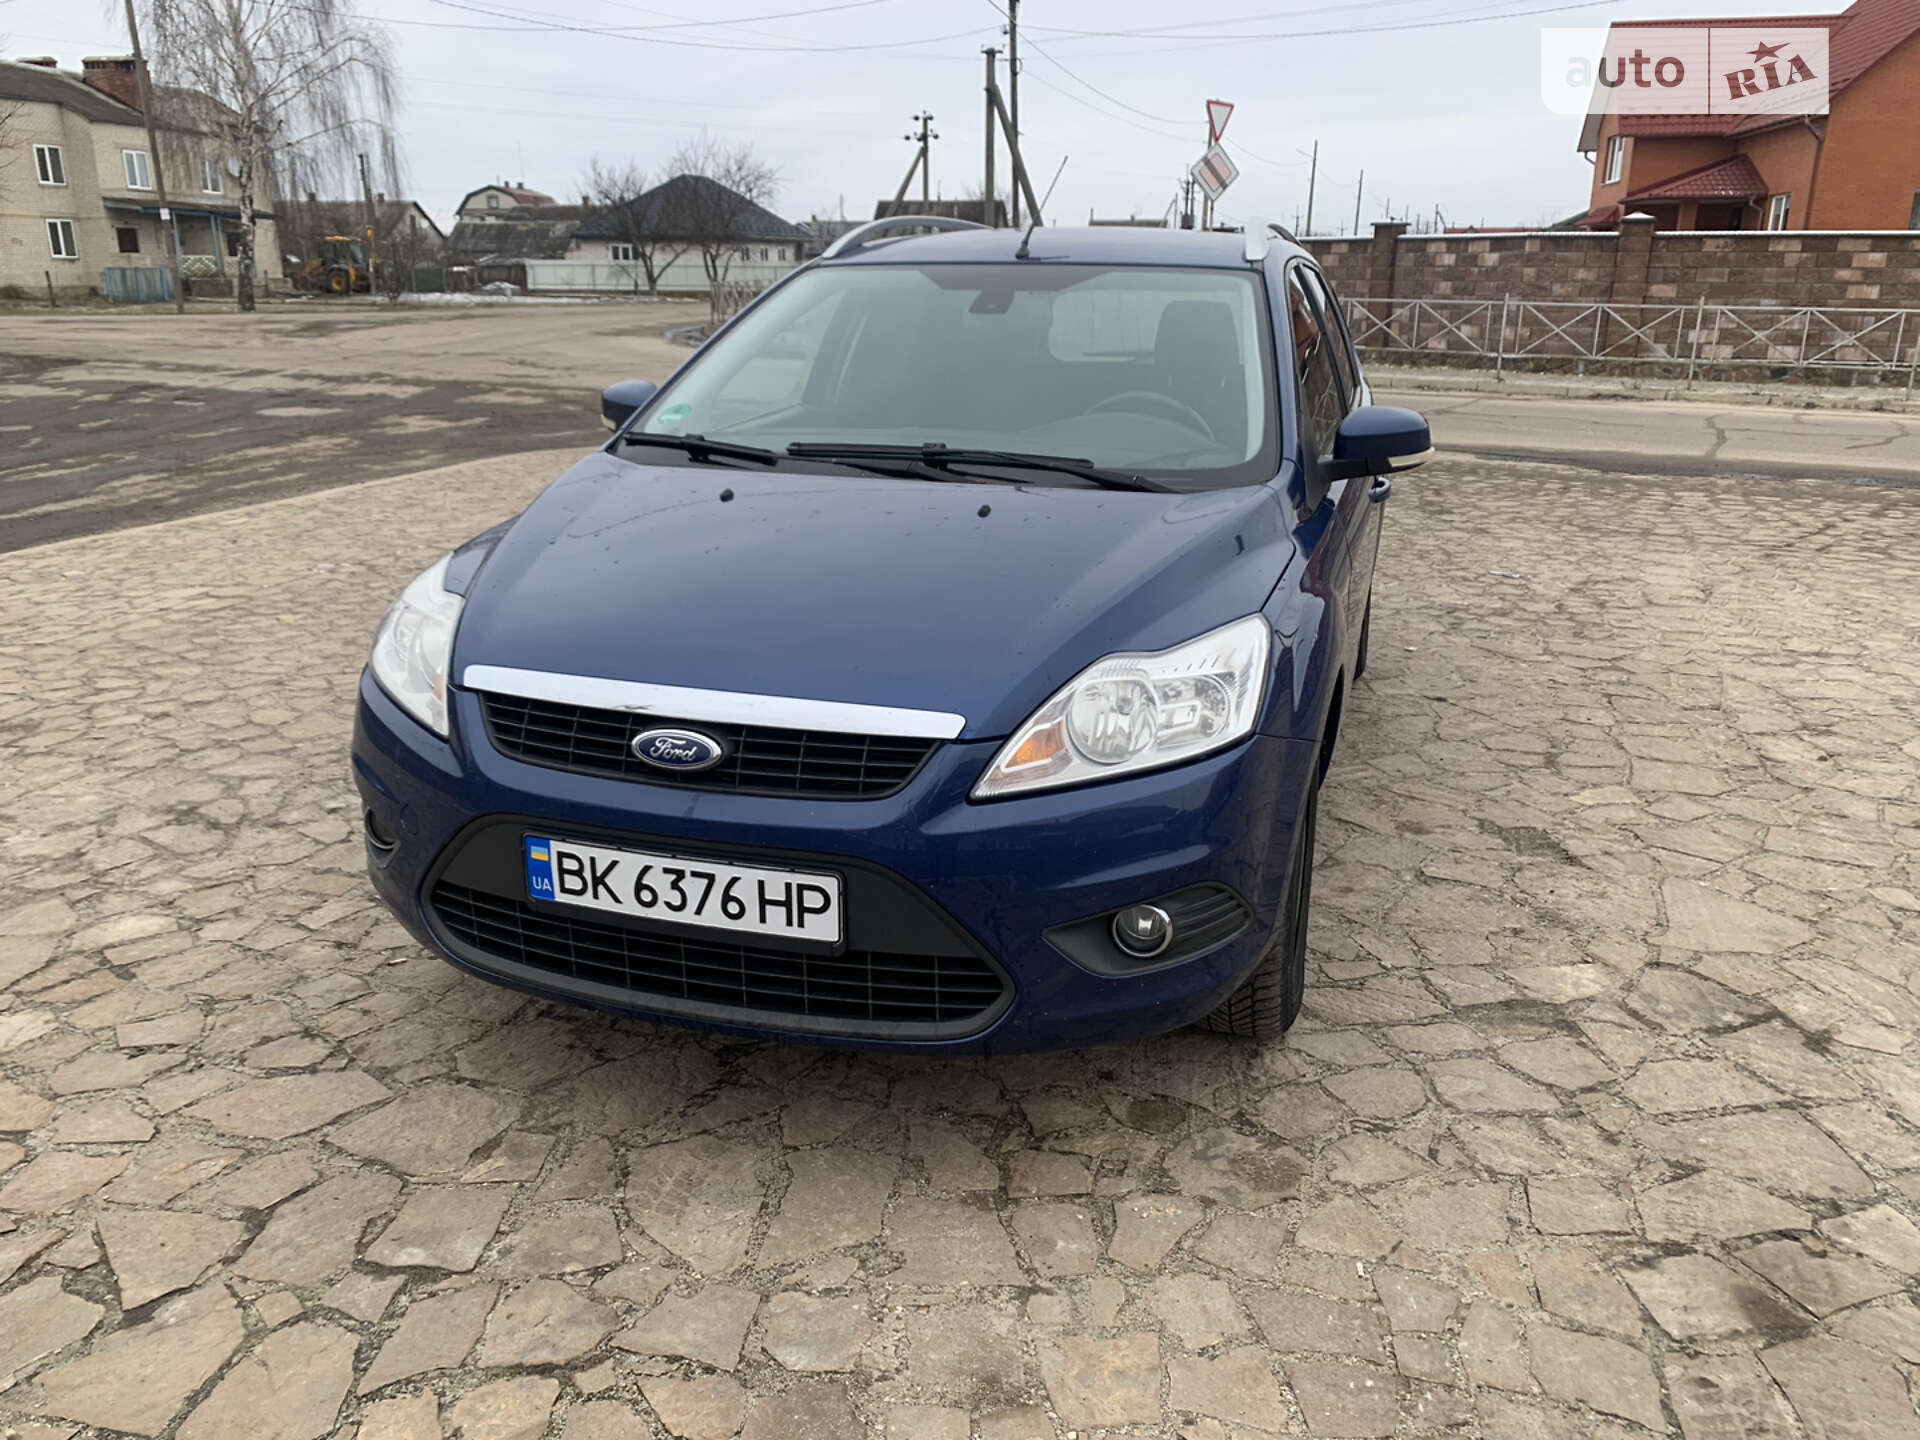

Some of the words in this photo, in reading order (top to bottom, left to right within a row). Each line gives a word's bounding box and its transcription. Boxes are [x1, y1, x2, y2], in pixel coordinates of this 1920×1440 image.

[649, 736, 698, 761] Ford
[532, 875, 552, 892] UA
[556, 849, 623, 904] BK
[634, 864, 746, 921] 6376
[757, 879, 831, 929] HP
